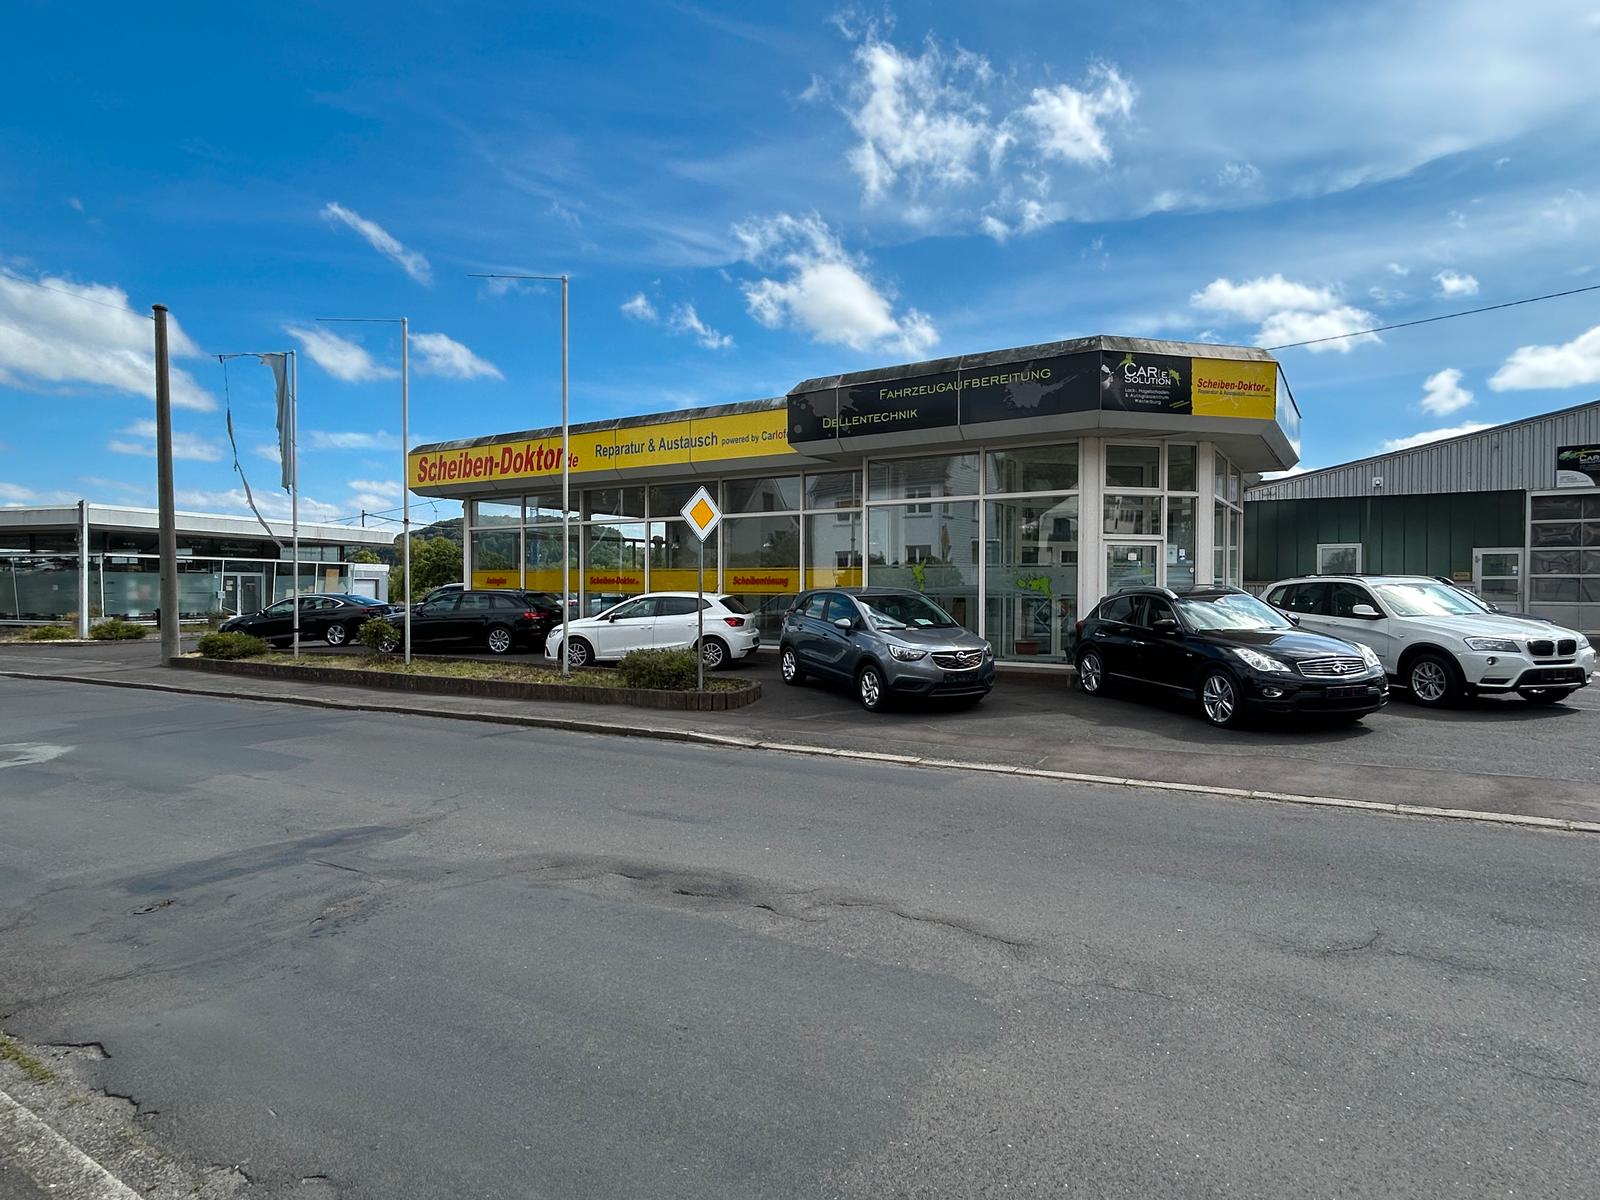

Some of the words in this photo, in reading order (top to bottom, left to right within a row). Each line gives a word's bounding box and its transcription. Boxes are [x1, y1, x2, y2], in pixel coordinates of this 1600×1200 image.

[879, 368, 1051, 400] FAHRZEUGAUFBEREITUNG
[1125, 375, 1171, 385] SOLUTION
[822, 409, 918, 429] DELLENTECHNIK
[595, 441, 645, 460] Reparatur
[648, 438, 656, 452] &
[658, 432, 718, 451] Austausch
[721, 435, 750, 447] powered
[751, 434, 759, 443] by
[761, 429, 788, 441] Carlof
[732, 575, 789, 588] Scheibentönung
